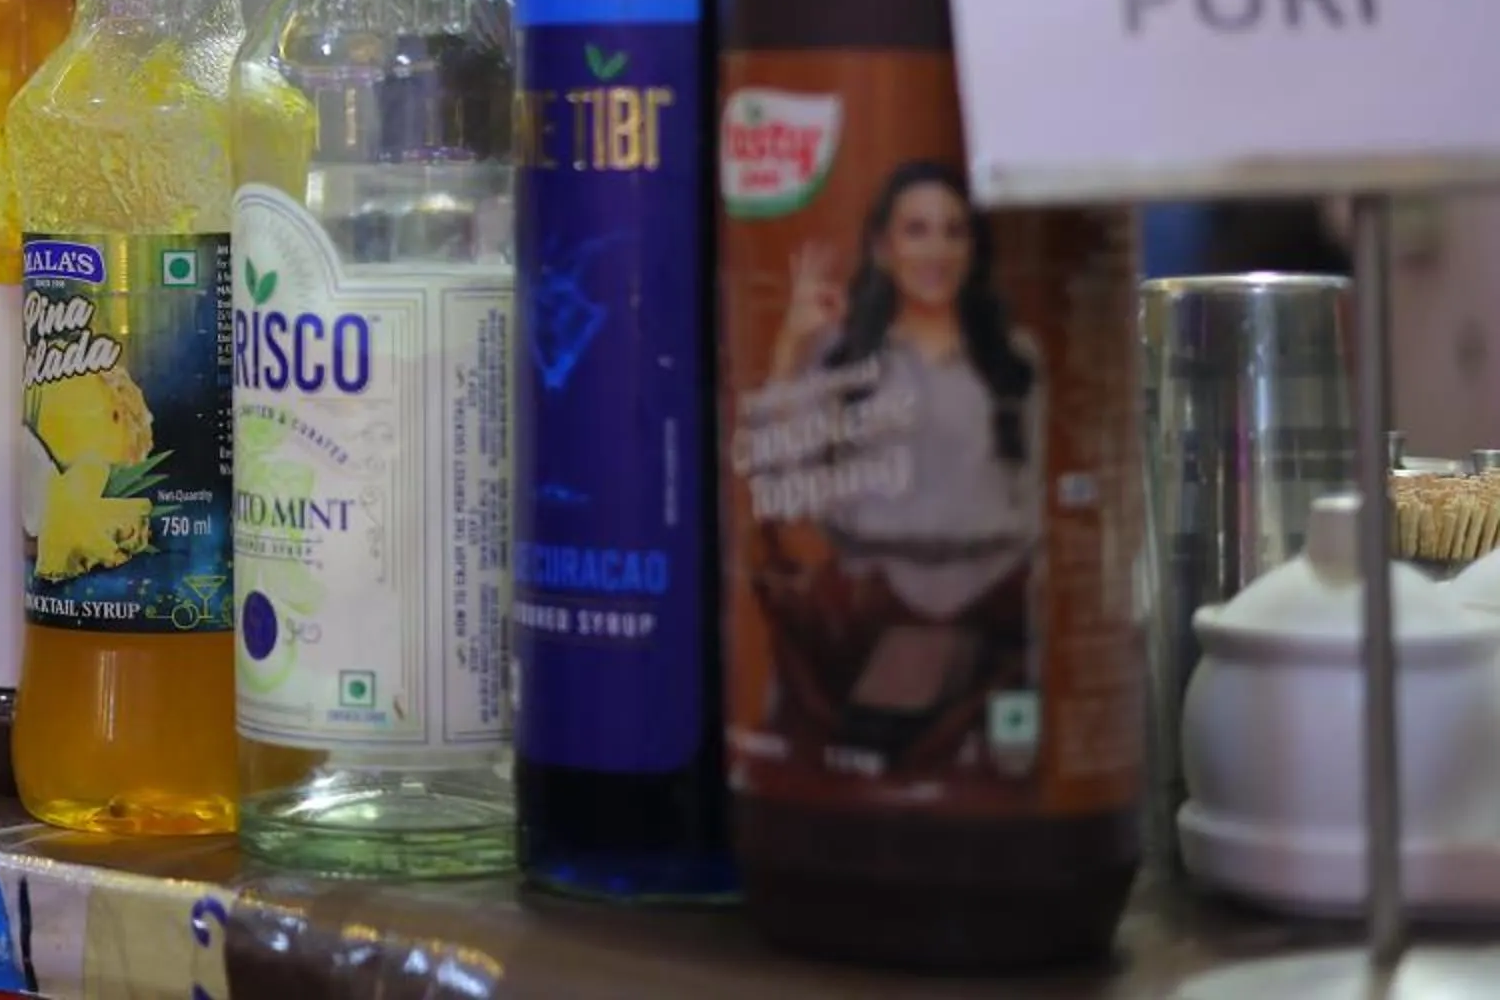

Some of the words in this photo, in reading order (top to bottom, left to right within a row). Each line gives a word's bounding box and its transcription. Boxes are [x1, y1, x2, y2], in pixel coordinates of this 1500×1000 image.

[24, 290, 94, 346] Pina
[24, 328, 121, 388] olada
[161, 516, 190, 536] 750
[193, 515, 212, 535] ml
[270, 497, 355, 532] MINT
[25, 591, 79, 617] CKTAIL
[81, 600, 141, 619] SYRUP
[453, 609, 467, 637] HOW
